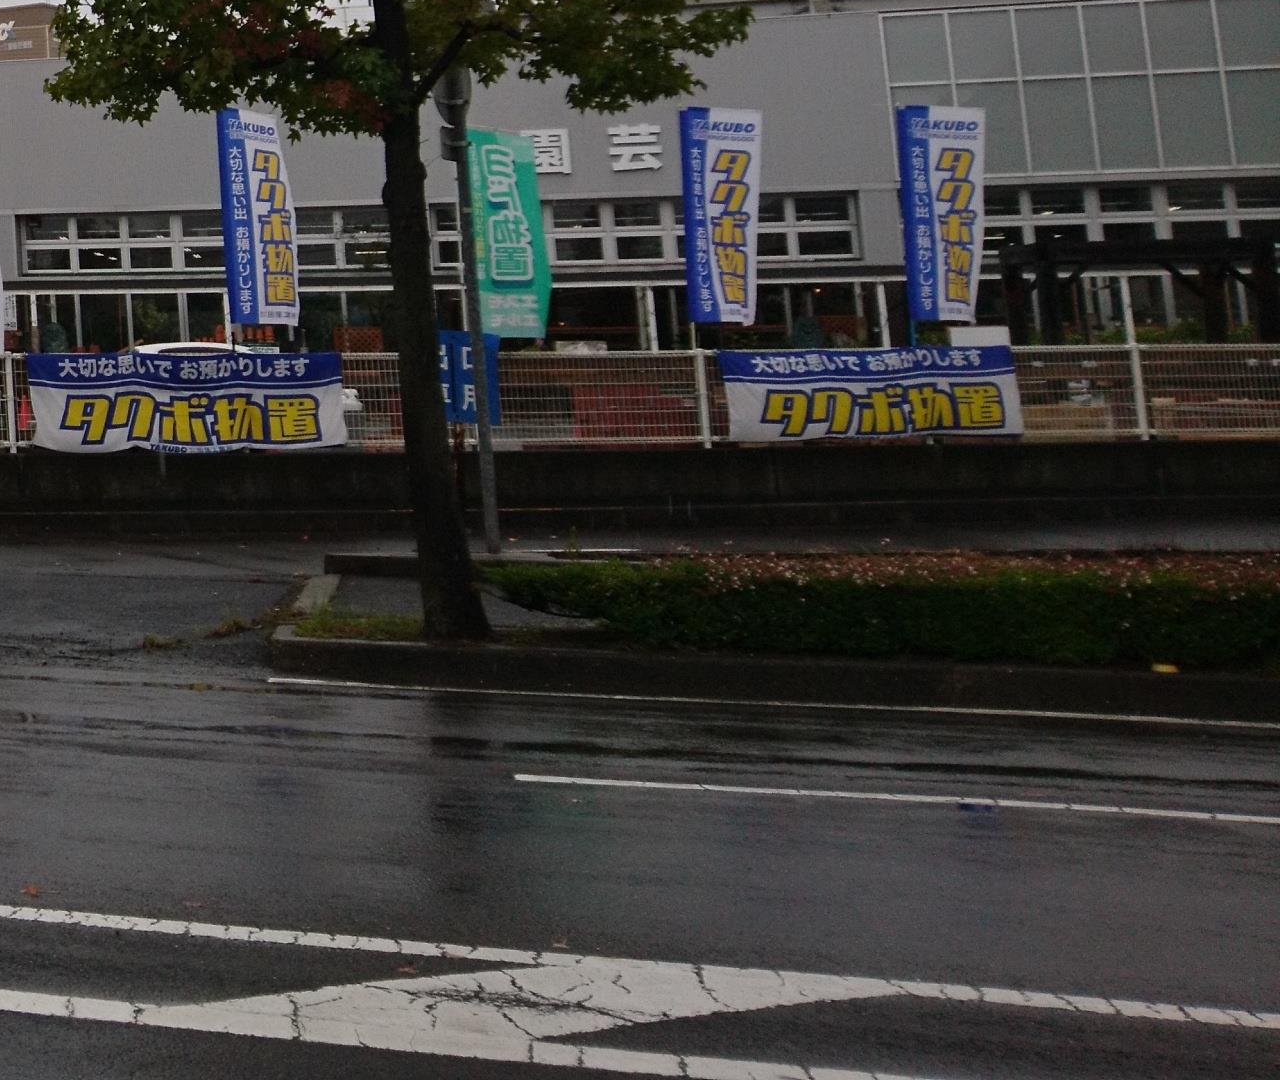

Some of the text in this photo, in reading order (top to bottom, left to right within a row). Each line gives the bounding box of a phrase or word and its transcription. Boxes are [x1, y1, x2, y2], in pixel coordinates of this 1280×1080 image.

[228, 118, 276, 138] TAKUBO
[693, 118, 756, 134] TAKUBO
[911, 117, 978, 133] TAKUBO
[228, 147, 254, 315] 大切な思い出 お預かりします
[251, 148, 298, 308] タクボ物置
[710, 148, 752, 307] タクボ物置
[934, 147, 978, 307] タクボ物置
[57, 356, 311, 381] 大切な思いで お預かりします
[750, 348, 983, 375] 大切な思いで お預かりします
[59, 390, 322, 446] タクボ物置
[759, 381, 1006, 438] タクボ物置
[150, 443, 189, 454] TAKUBO
